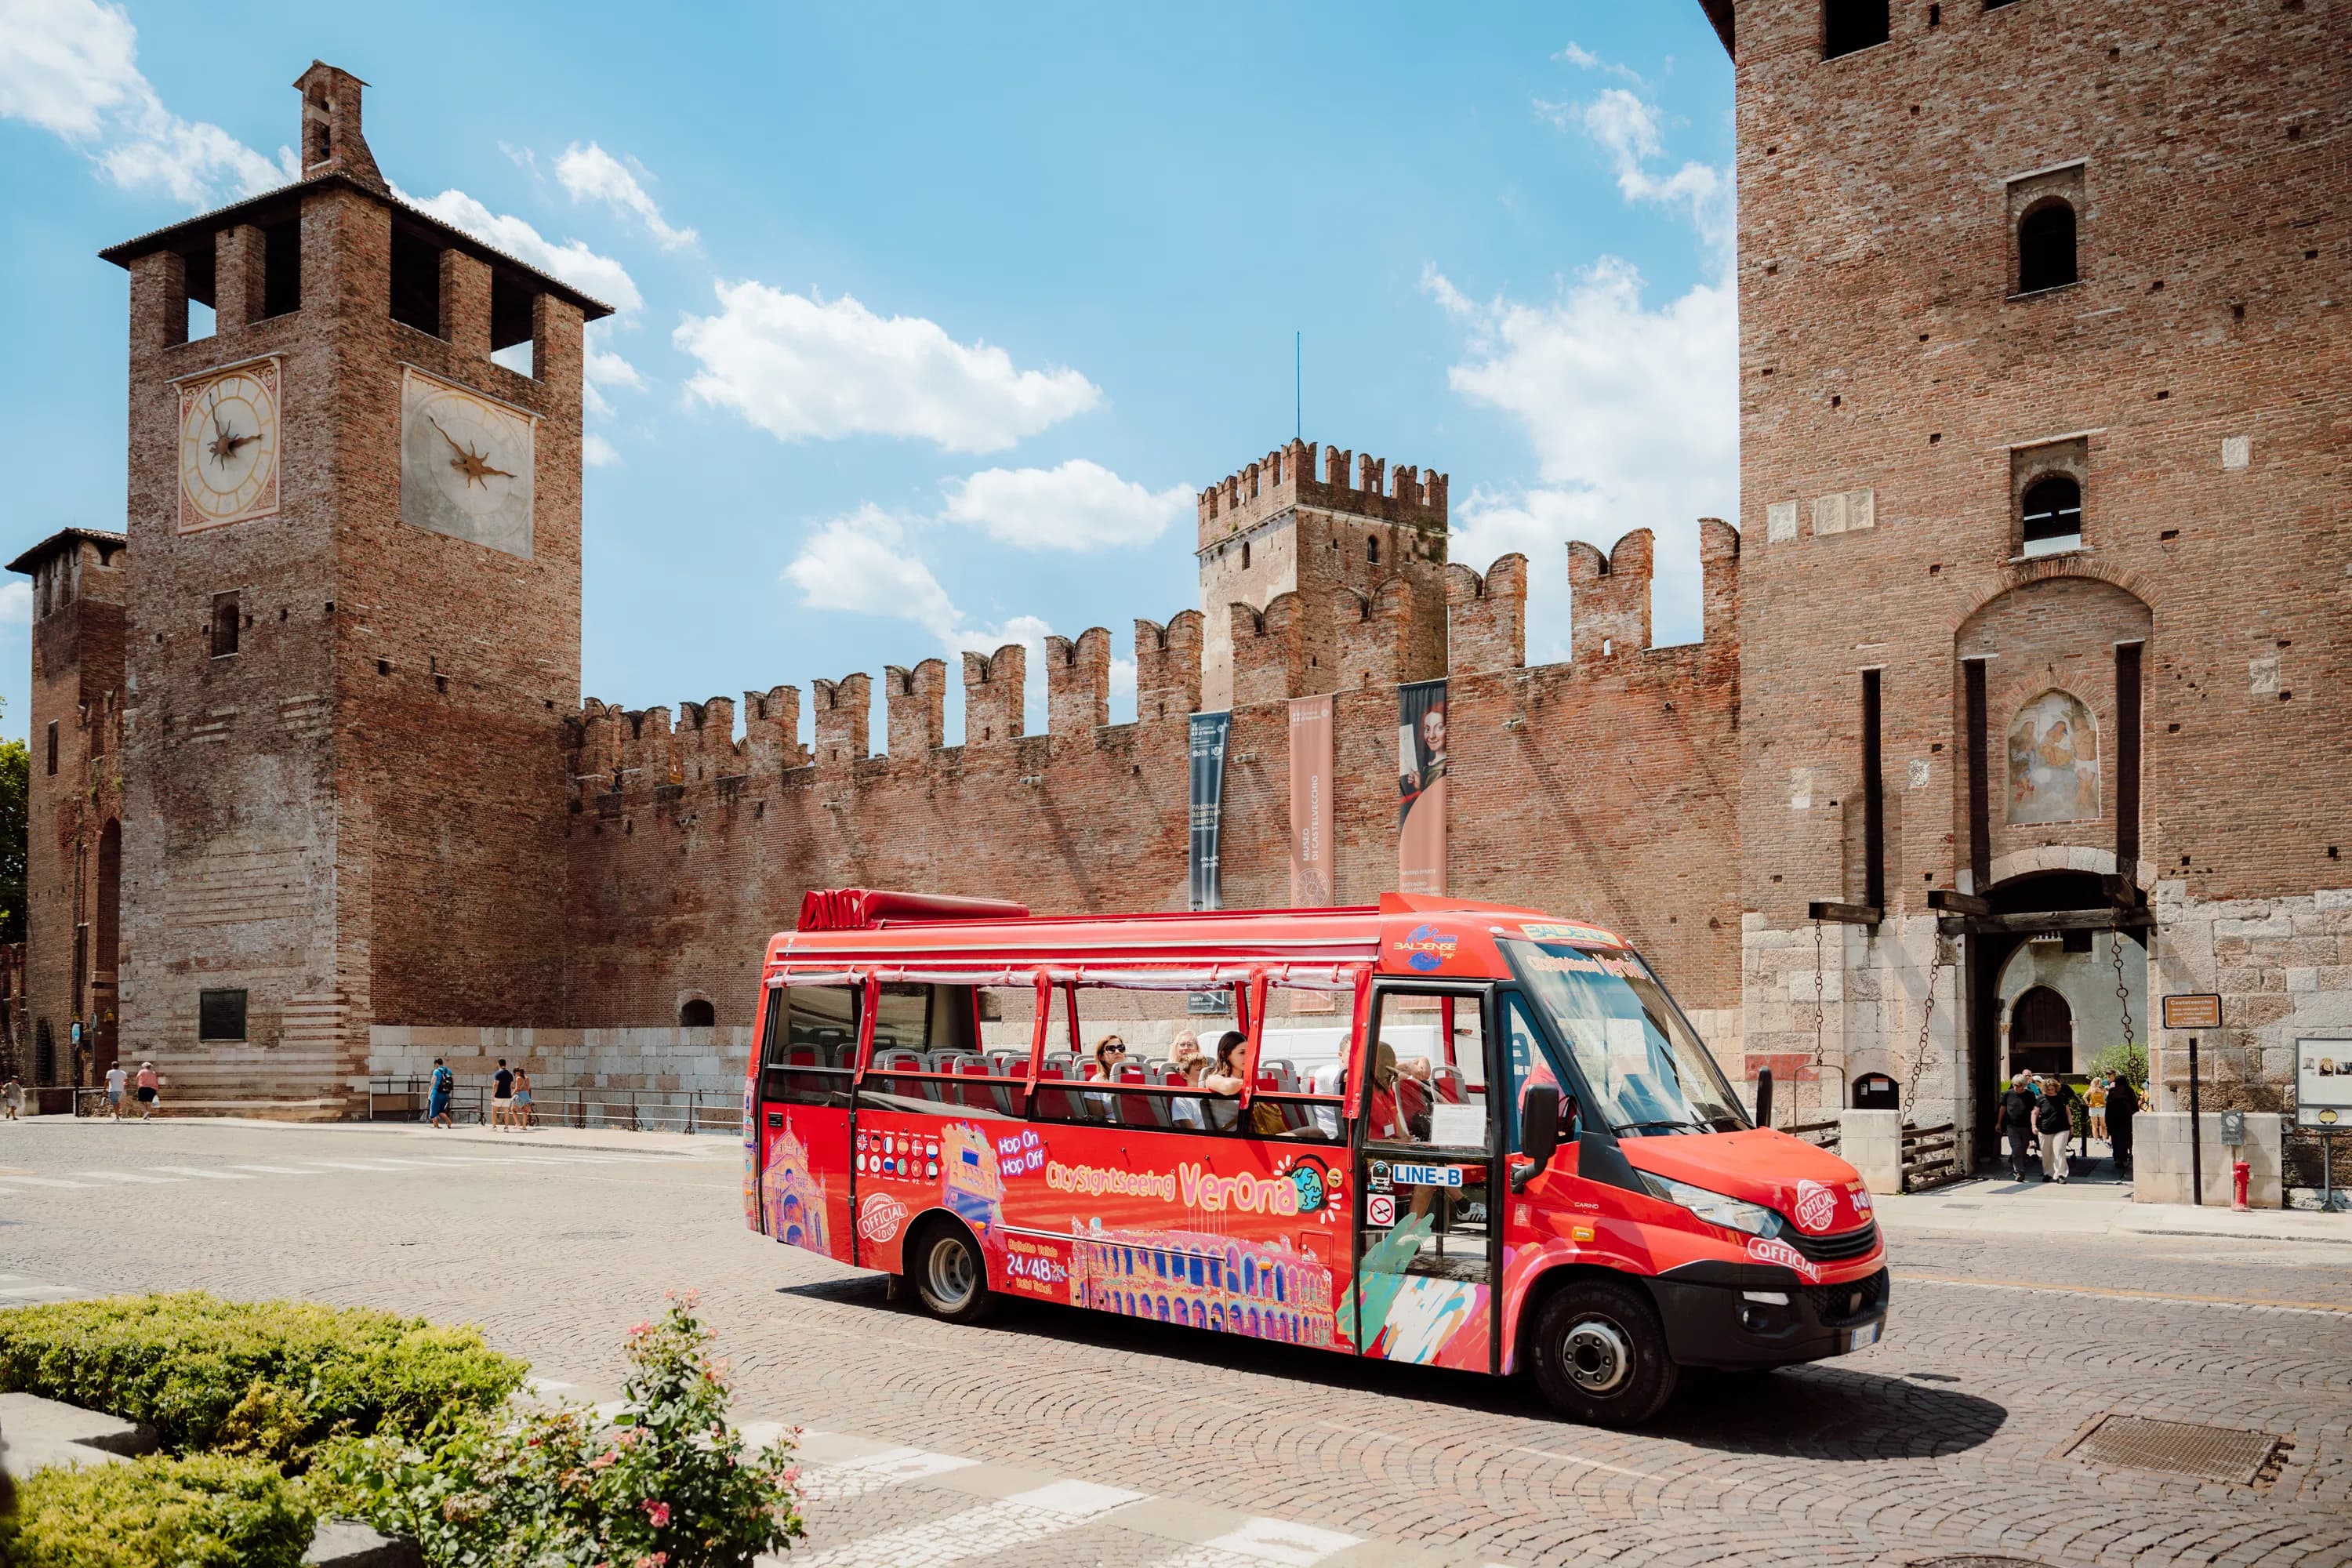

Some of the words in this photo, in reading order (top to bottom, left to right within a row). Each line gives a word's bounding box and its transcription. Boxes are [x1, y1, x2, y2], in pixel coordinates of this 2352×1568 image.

[1312, 851, 1319, 860] DI
[1392, 942, 1457, 951] BALDENSE
[998, 1137, 1021, 1155] Hop
[1022, 1130, 1040, 1148] On
[1002, 1158, 1025, 1175] Hop
[1025, 1149, 1044, 1170] Off
[1395, 1166, 1461, 1185] LINE-B
[1178, 1162, 1298, 1216] Verona
[1800, 1191, 1835, 1221] OFFICIAL
[1816, 1210, 1832, 1226] TOUR
[862, 1205, 906, 1233] OFFICIAL
[877, 1222, 896, 1239] TOUR
[1007, 1253, 1051, 1282] 24/48
[1758, 1243, 1817, 1280] OFFICIAL
